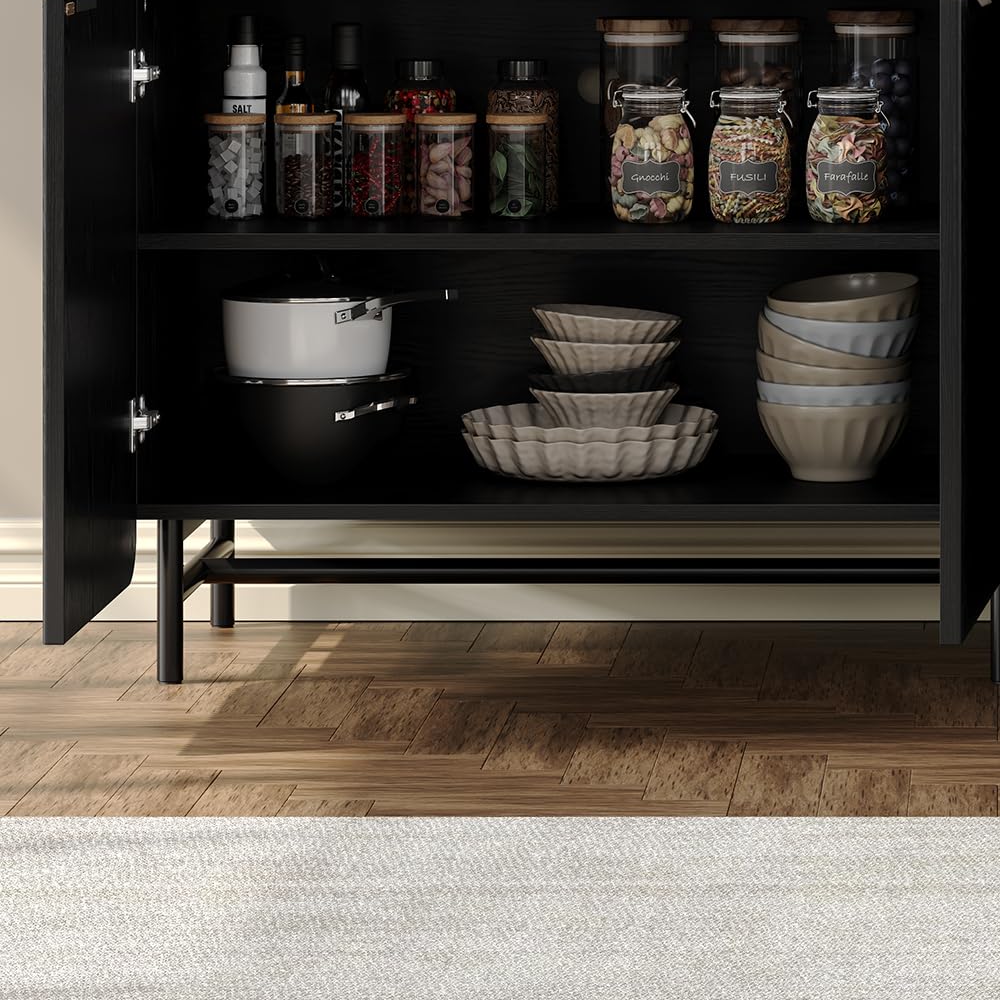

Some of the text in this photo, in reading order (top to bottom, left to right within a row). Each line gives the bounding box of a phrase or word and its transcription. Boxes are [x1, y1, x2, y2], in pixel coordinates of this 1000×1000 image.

[232, 104, 252, 114] SALT
[630, 172, 670, 183] Gnocchi
[729, 173, 767, 182] FUSILI
